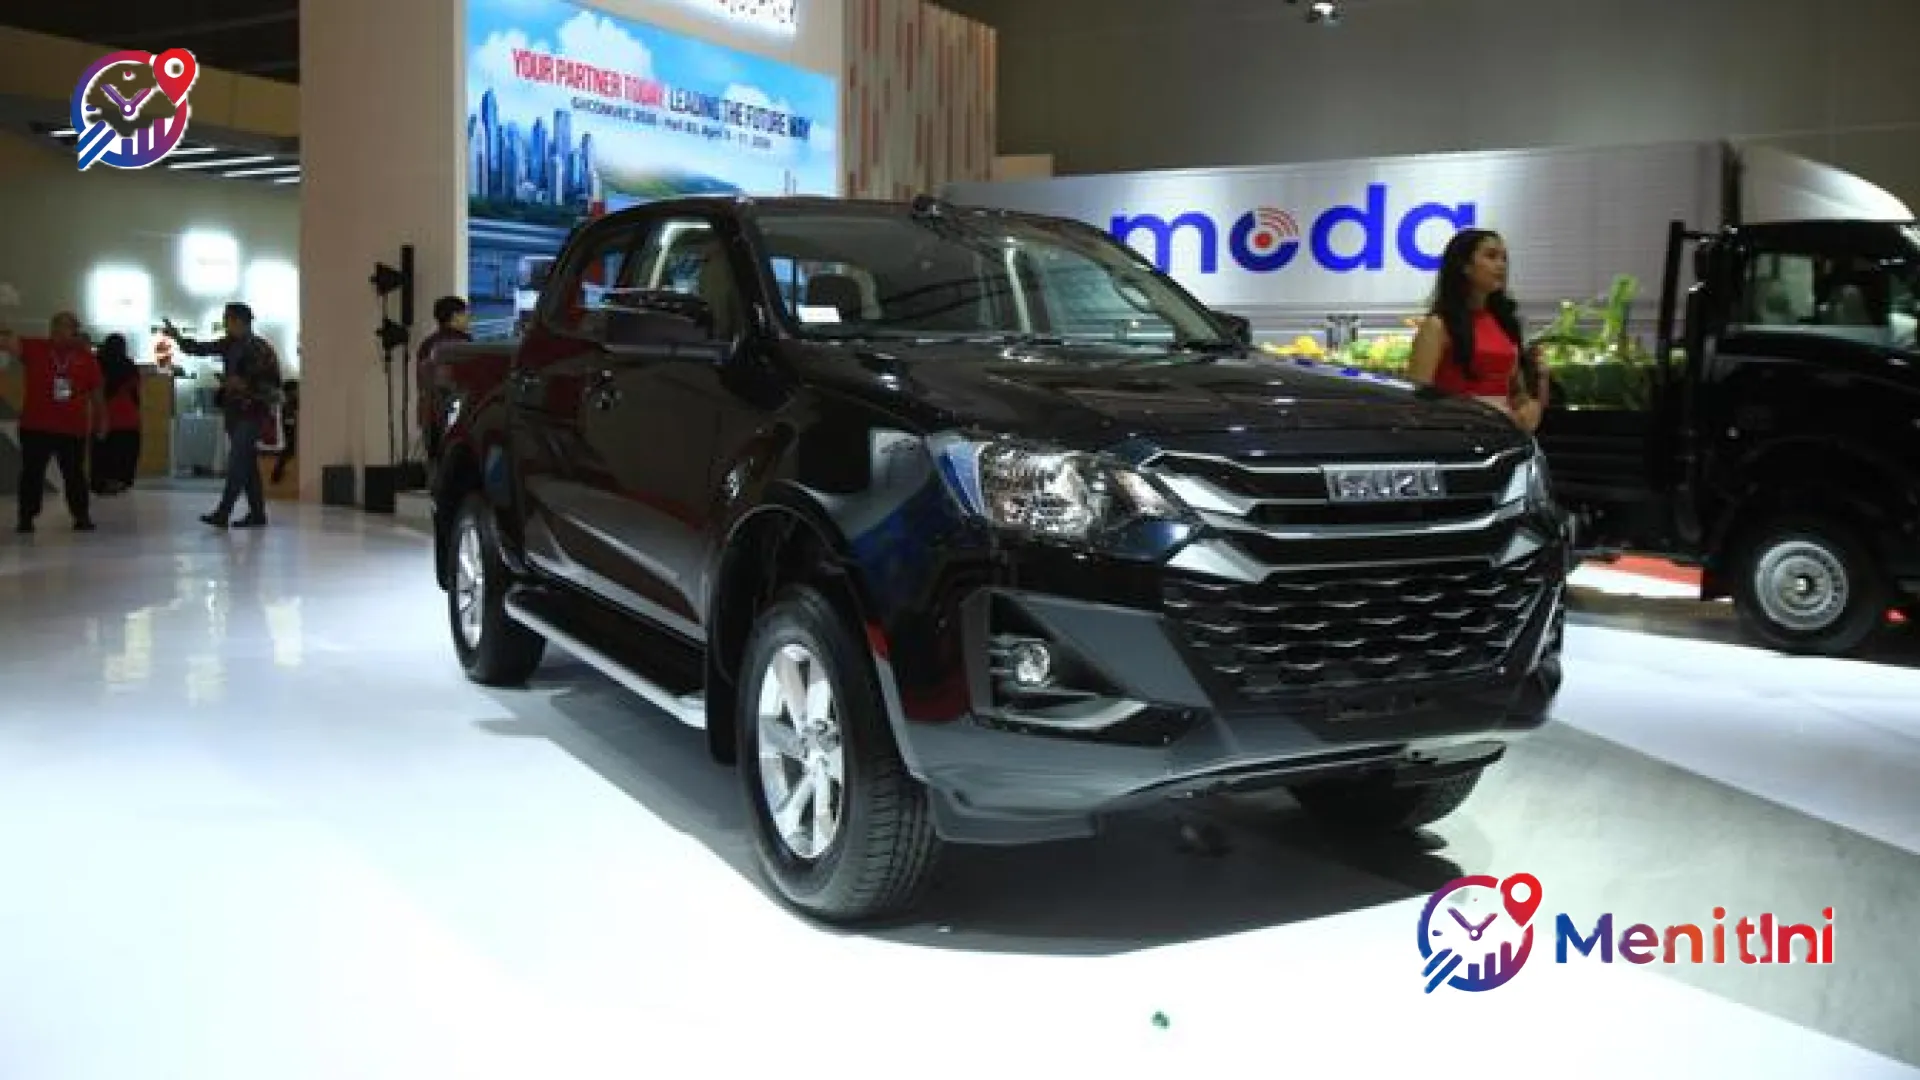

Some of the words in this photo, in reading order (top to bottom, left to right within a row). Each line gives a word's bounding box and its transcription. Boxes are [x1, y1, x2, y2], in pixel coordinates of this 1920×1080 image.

[512, 48, 554, 84] YOUR
[555, 56, 622, 99] PARTNER
[1110, 183, 1477, 274] moda
